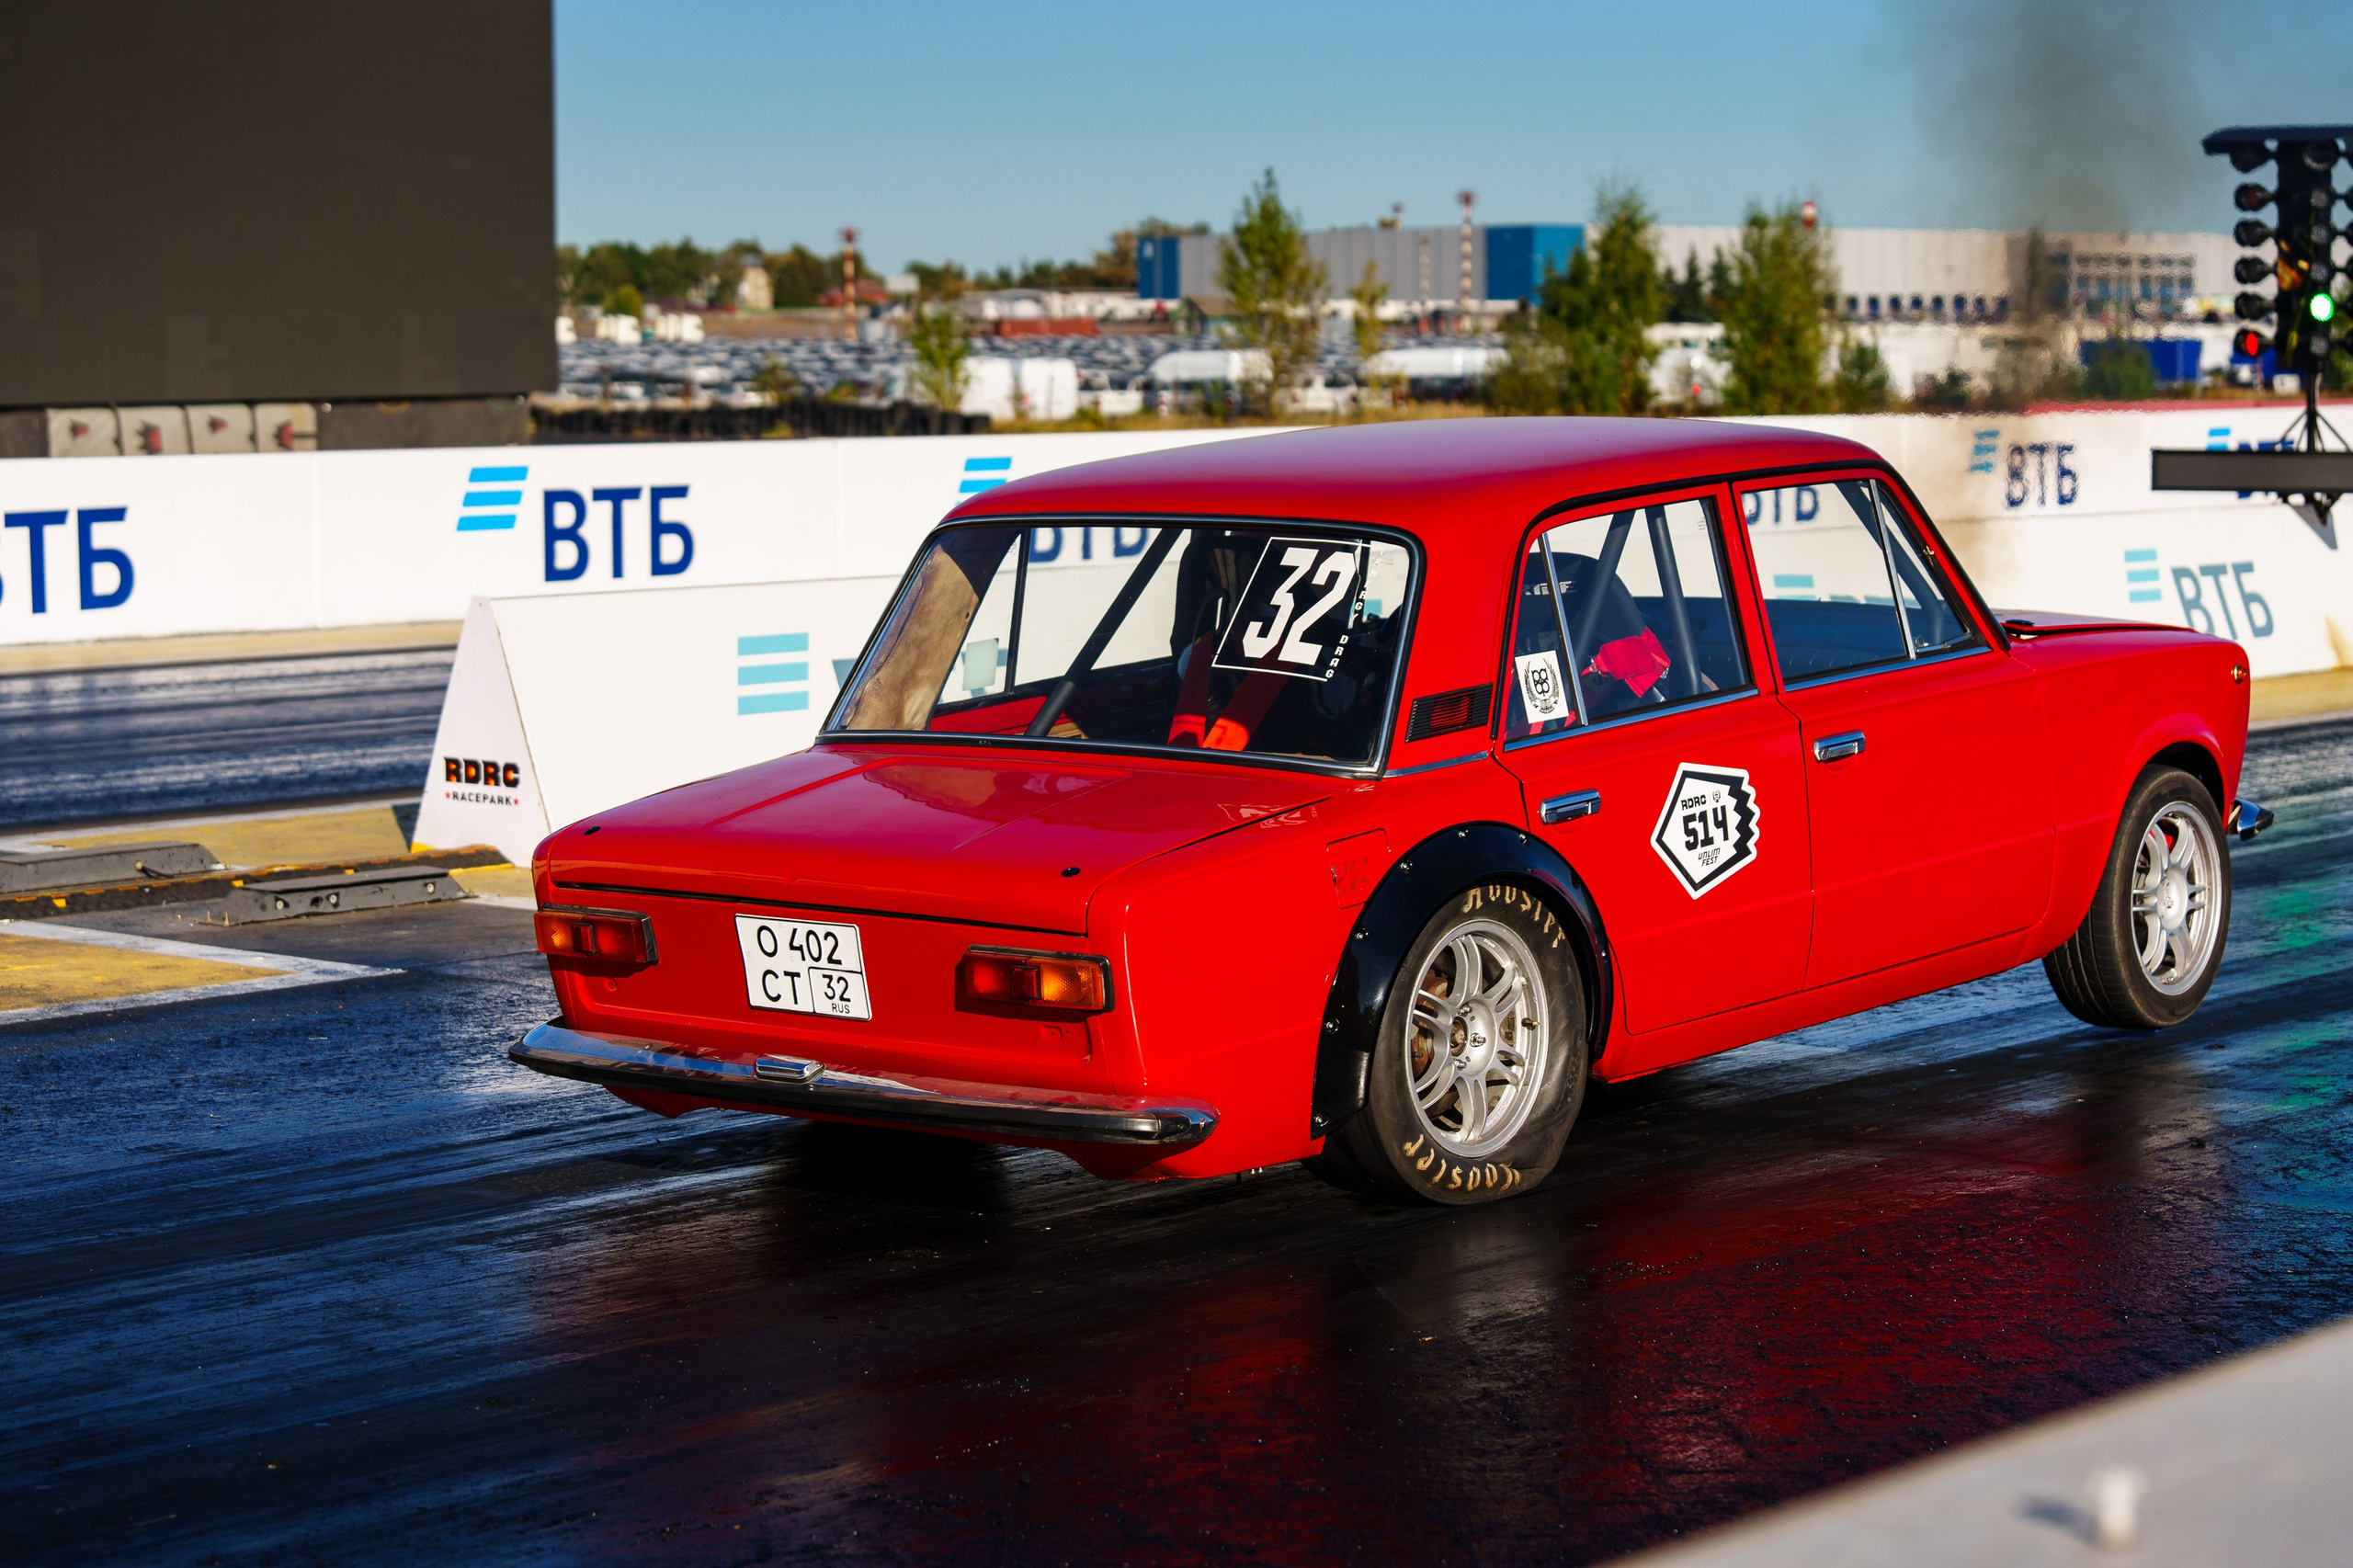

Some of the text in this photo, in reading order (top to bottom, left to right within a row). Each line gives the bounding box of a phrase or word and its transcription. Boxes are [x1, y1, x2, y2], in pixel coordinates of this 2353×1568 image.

[2006, 442, 2078, 509] ВТБ
[543, 484, 695, 583] ВТБ
[0, 506, 135, 614] ТБ
[1243, 547, 1357, 665] 32
[2171, 562, 2275, 641] ВТБ
[1324, 634, 1349, 679] DRAG
[444, 756, 520, 788] RDRC
[452, 790, 512, 806] RACEPARK
[1680, 794, 1707, 811] RDRC
[1682, 804, 1730, 852] 514
[1701, 856, 1719, 867] FEST
[789, 927, 843, 965] 402
[822, 973, 851, 1003] 32
[831, 1003, 850, 1015] RUS
